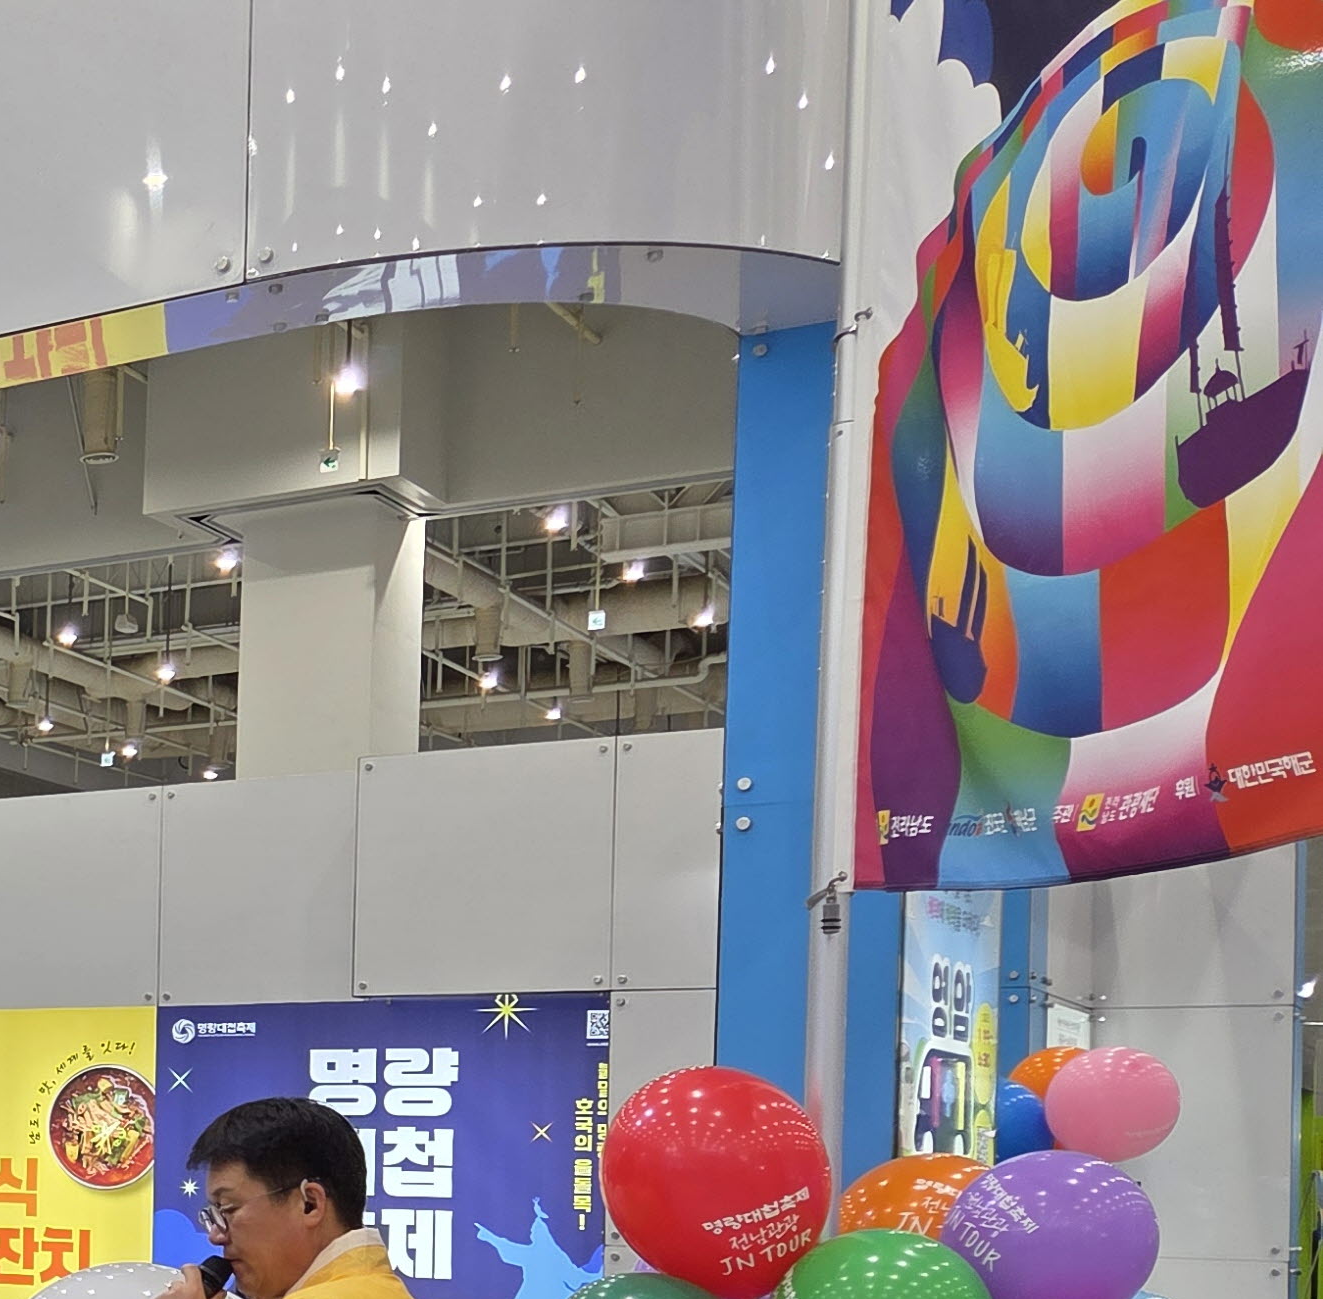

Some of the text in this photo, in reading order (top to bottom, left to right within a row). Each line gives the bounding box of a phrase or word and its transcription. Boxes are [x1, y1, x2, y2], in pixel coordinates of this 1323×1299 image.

[890, 813, 934, 838] 전라남도
[197, 1022, 257, 1034] 명량대첩축제
[28, 1103, 41, 1144] 남도의
[39, 1081, 56, 1095] 맛,
[101, 1041, 135, 1055] 잇다!
[308, 1047, 459, 1118] 명량
[574, 1098, 594, 1152] 호국의
[357, 1126, 454, 1199] 첩
[701, 1186, 810, 1235] 명량대첩축제
[729, 1213, 800, 1251] 전남관광
[720, 1228, 812, 1276] JN TOUR
[959, 1222, 1001, 1272] TOUR
